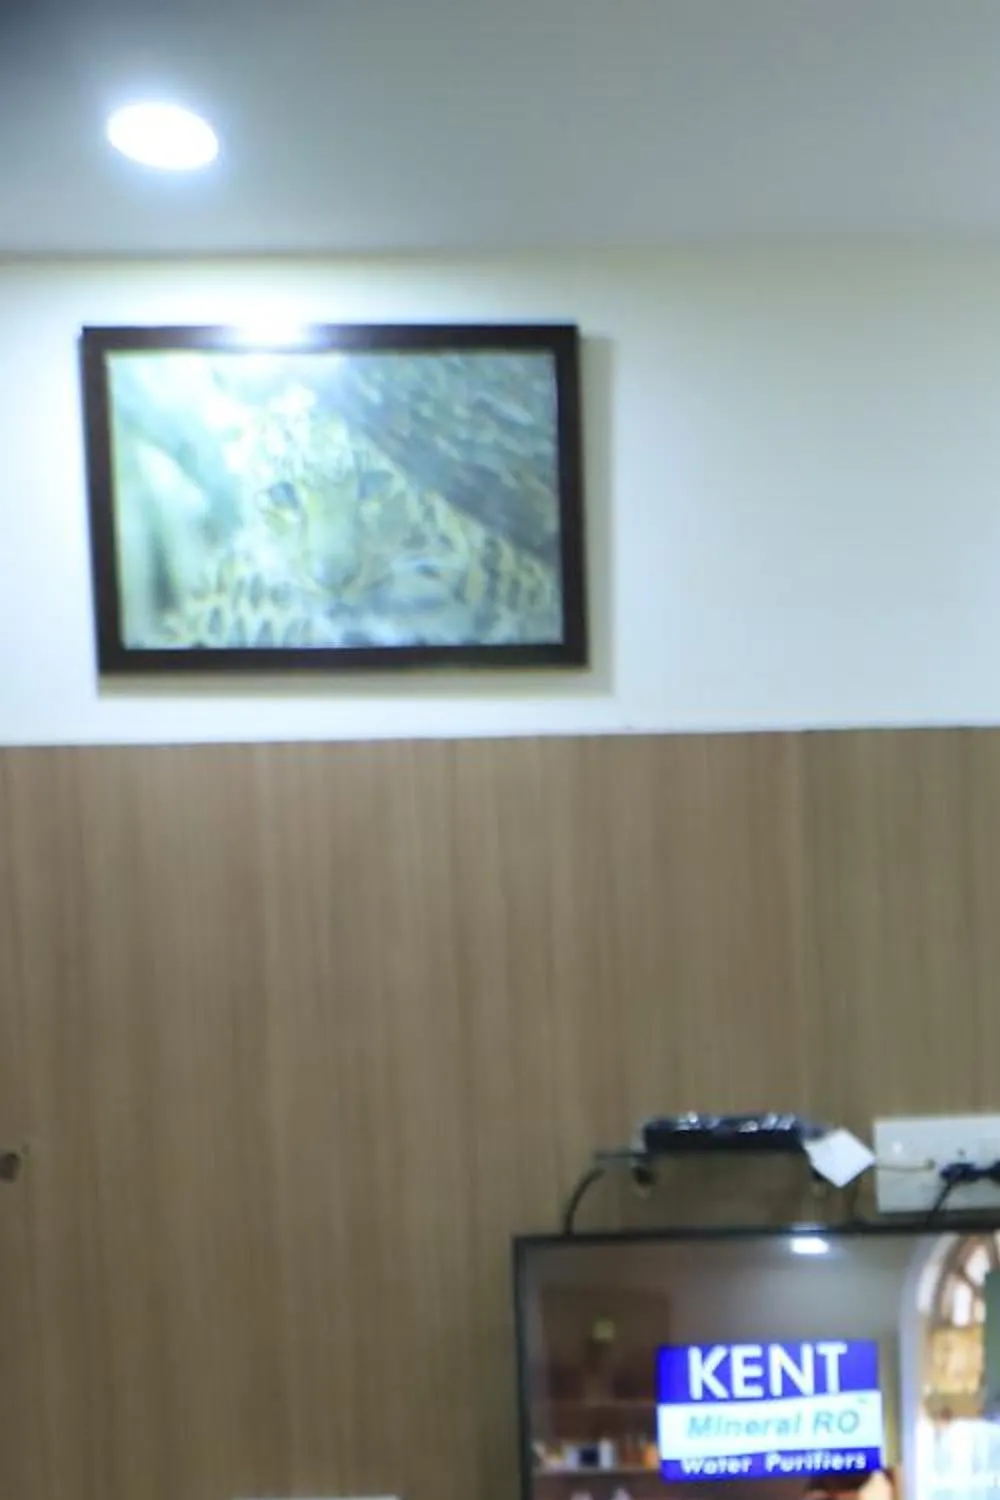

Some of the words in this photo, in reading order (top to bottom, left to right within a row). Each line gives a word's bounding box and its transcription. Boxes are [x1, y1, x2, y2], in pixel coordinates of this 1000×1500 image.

[687, 1341, 848, 1400] KENT
[687, 1412, 803, 1440] Mineral
[812, 1409, 862, 1434] RO
[681, 1454, 752, 1475] Water
[765, 1449, 866, 1473] Purifiers
